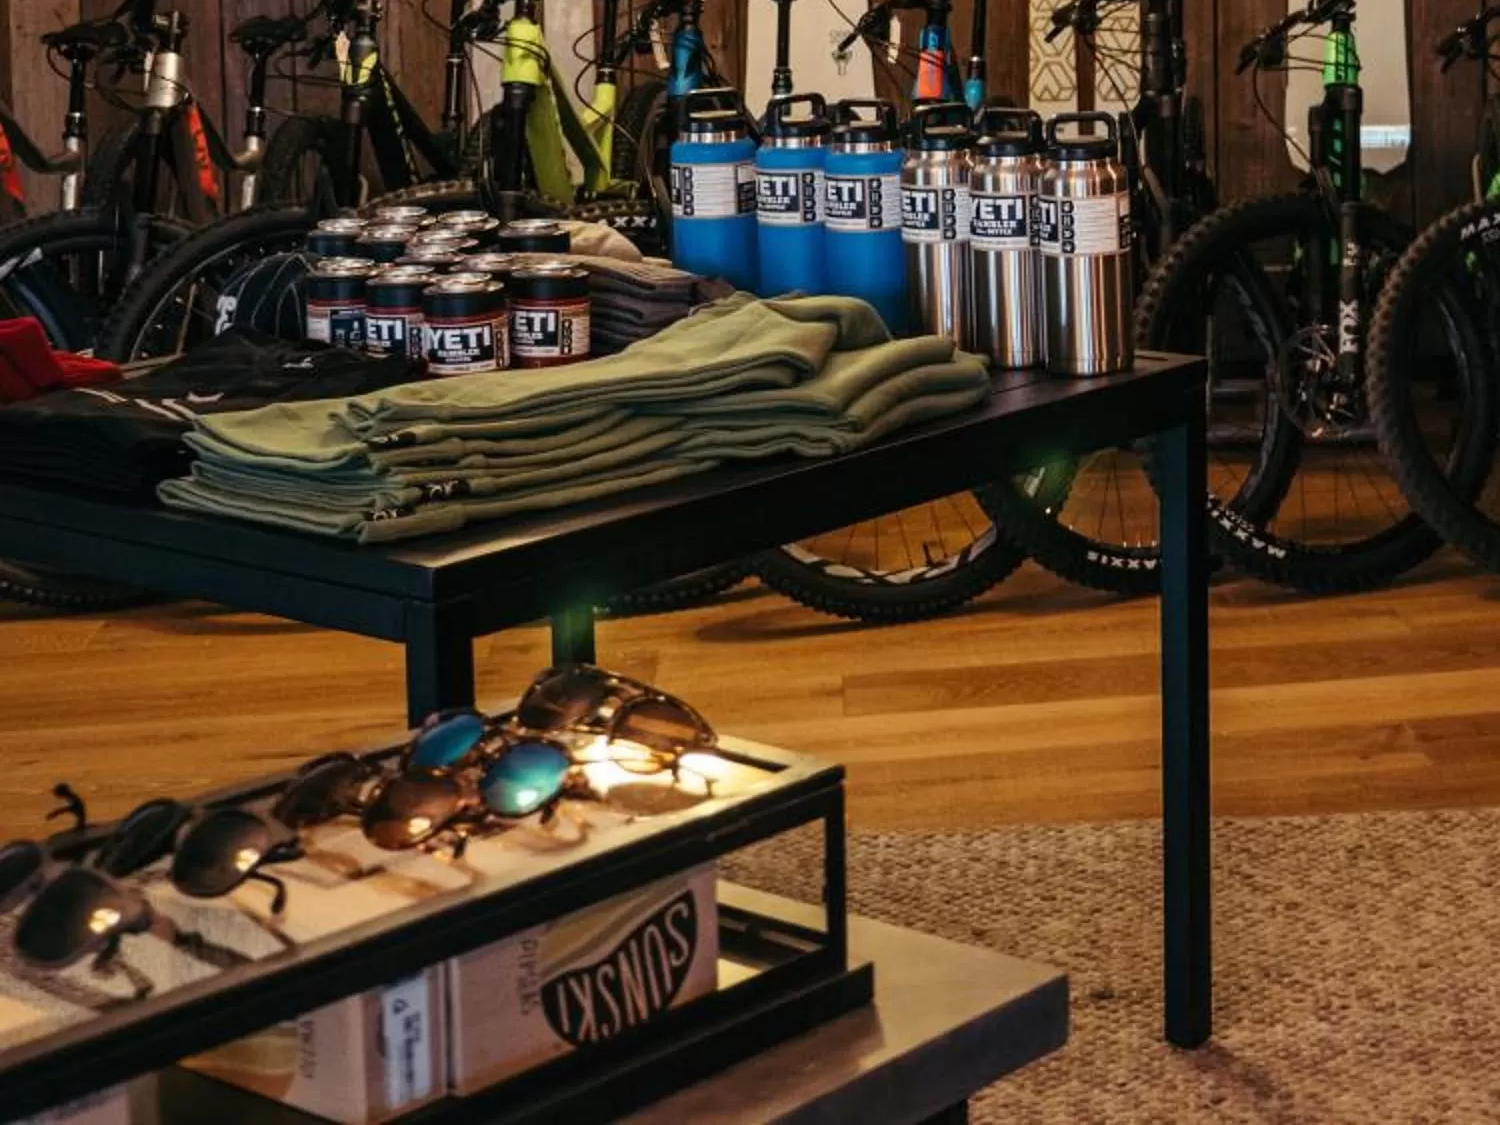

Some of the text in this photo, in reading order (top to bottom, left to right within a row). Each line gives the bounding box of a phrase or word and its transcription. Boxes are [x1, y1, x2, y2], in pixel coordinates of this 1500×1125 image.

[758, 175, 796, 196] ETI
[827, 181, 863, 202] ETI
[903, 191, 936, 213] ETI
[1039, 202, 1056, 224] TI
[365, 317, 403, 340] ETI
[514, 310, 555, 333] ETI
[1339, 299, 1360, 356] FOX
[428, 325, 491, 350] YETI
[1087, 550, 1158, 570] AXXIS
[556, 900, 690, 1043] SUNSKI
